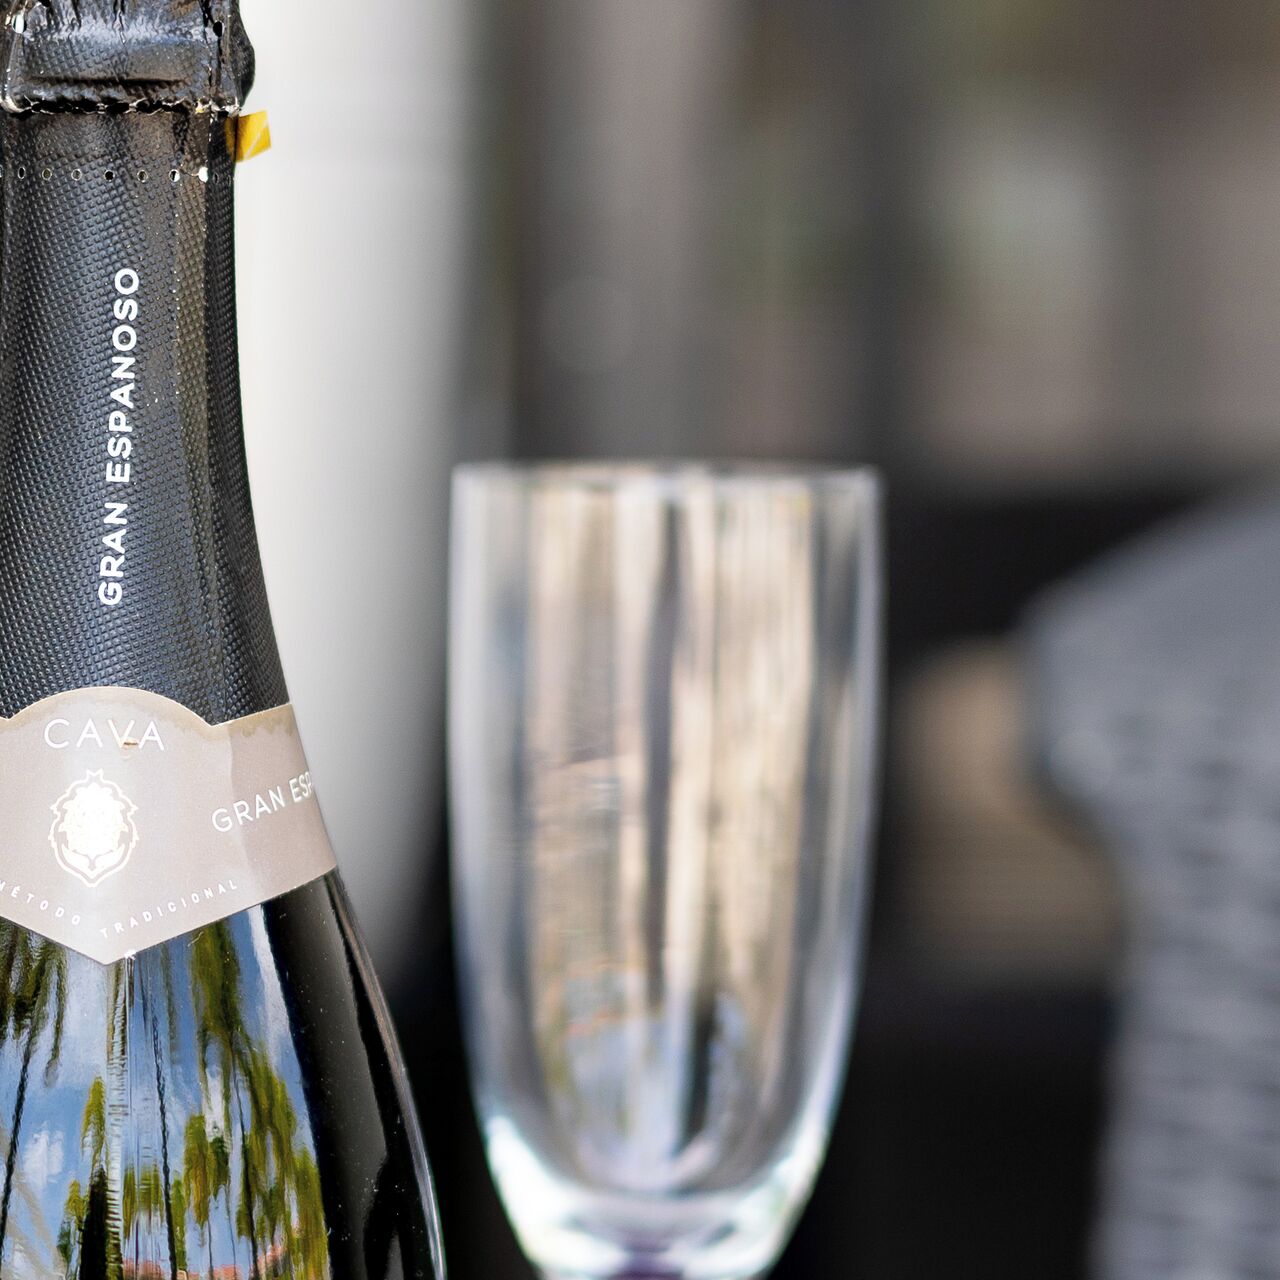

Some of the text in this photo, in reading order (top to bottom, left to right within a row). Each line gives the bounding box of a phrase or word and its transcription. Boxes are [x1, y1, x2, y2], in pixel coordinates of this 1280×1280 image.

[98, 268, 140, 606] GRAN ESPANOSO
[44, 718, 165, 751] CAVA
[212, 786, 286, 832] GRAN
[100, 879, 238, 939] TRADICIONAL
